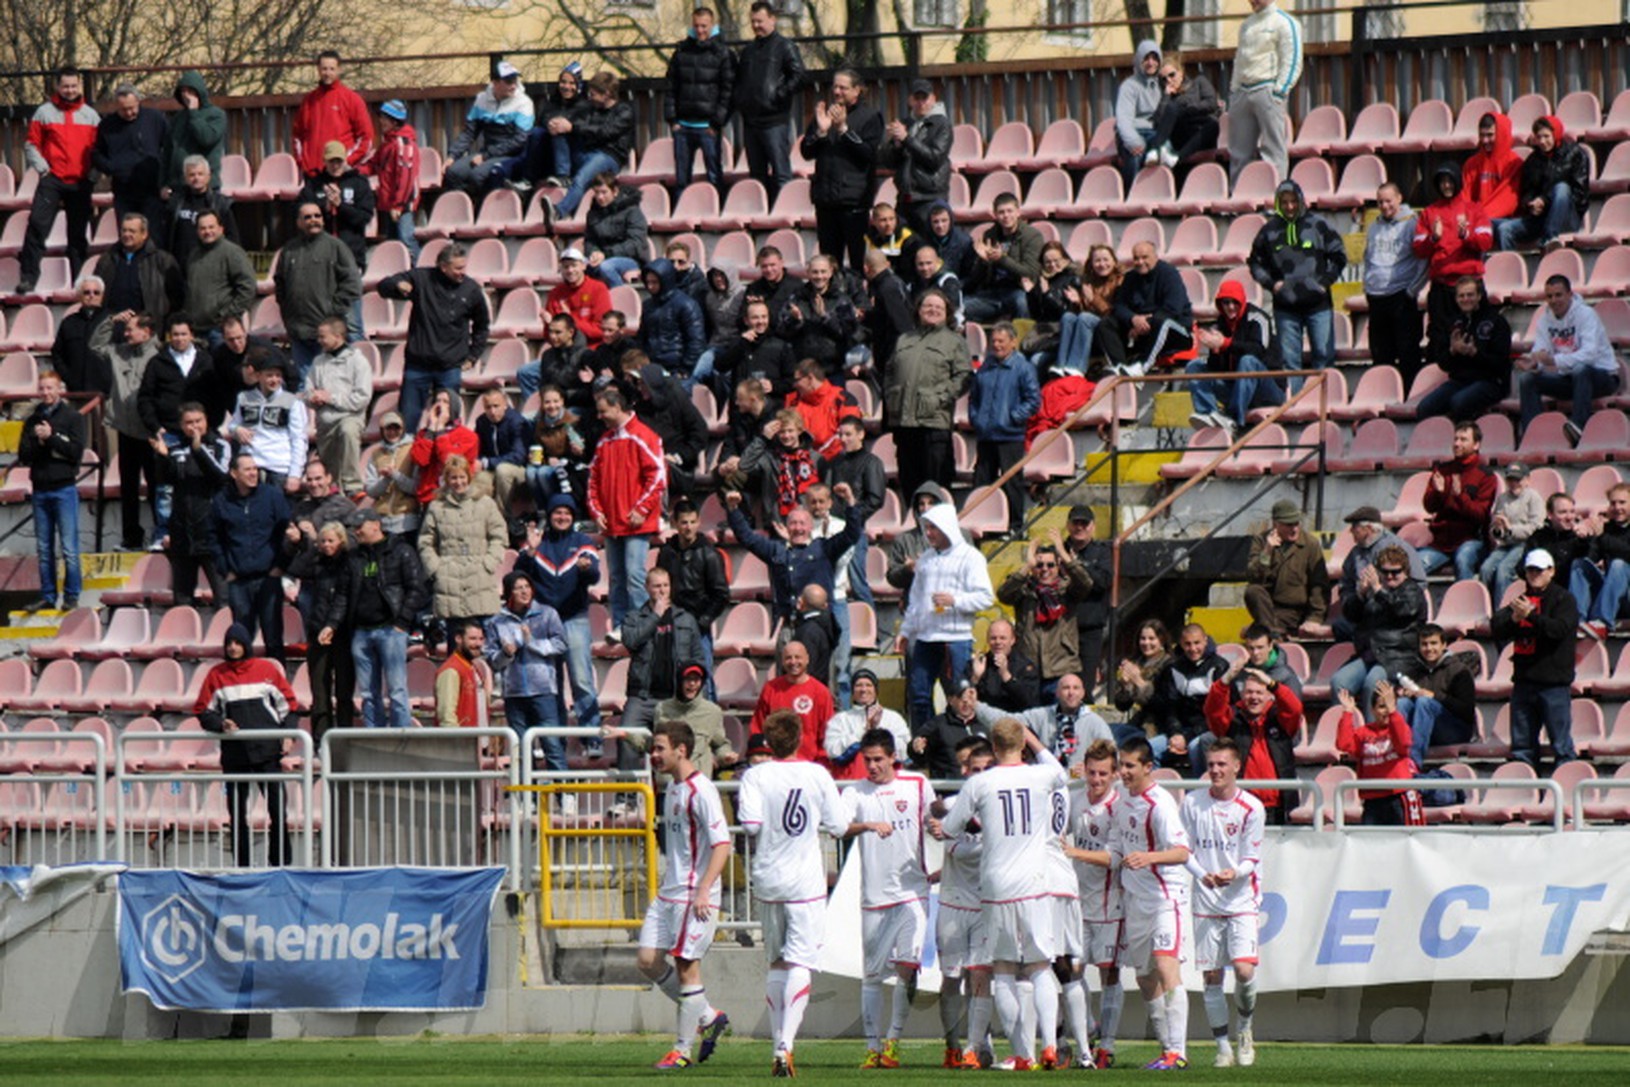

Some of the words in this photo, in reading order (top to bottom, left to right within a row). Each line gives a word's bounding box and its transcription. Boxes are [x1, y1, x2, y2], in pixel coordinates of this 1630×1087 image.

[782, 788, 808, 838] 6
[997, 788, 1031, 837] 11
[213, 911, 461, 963] Chemolak
